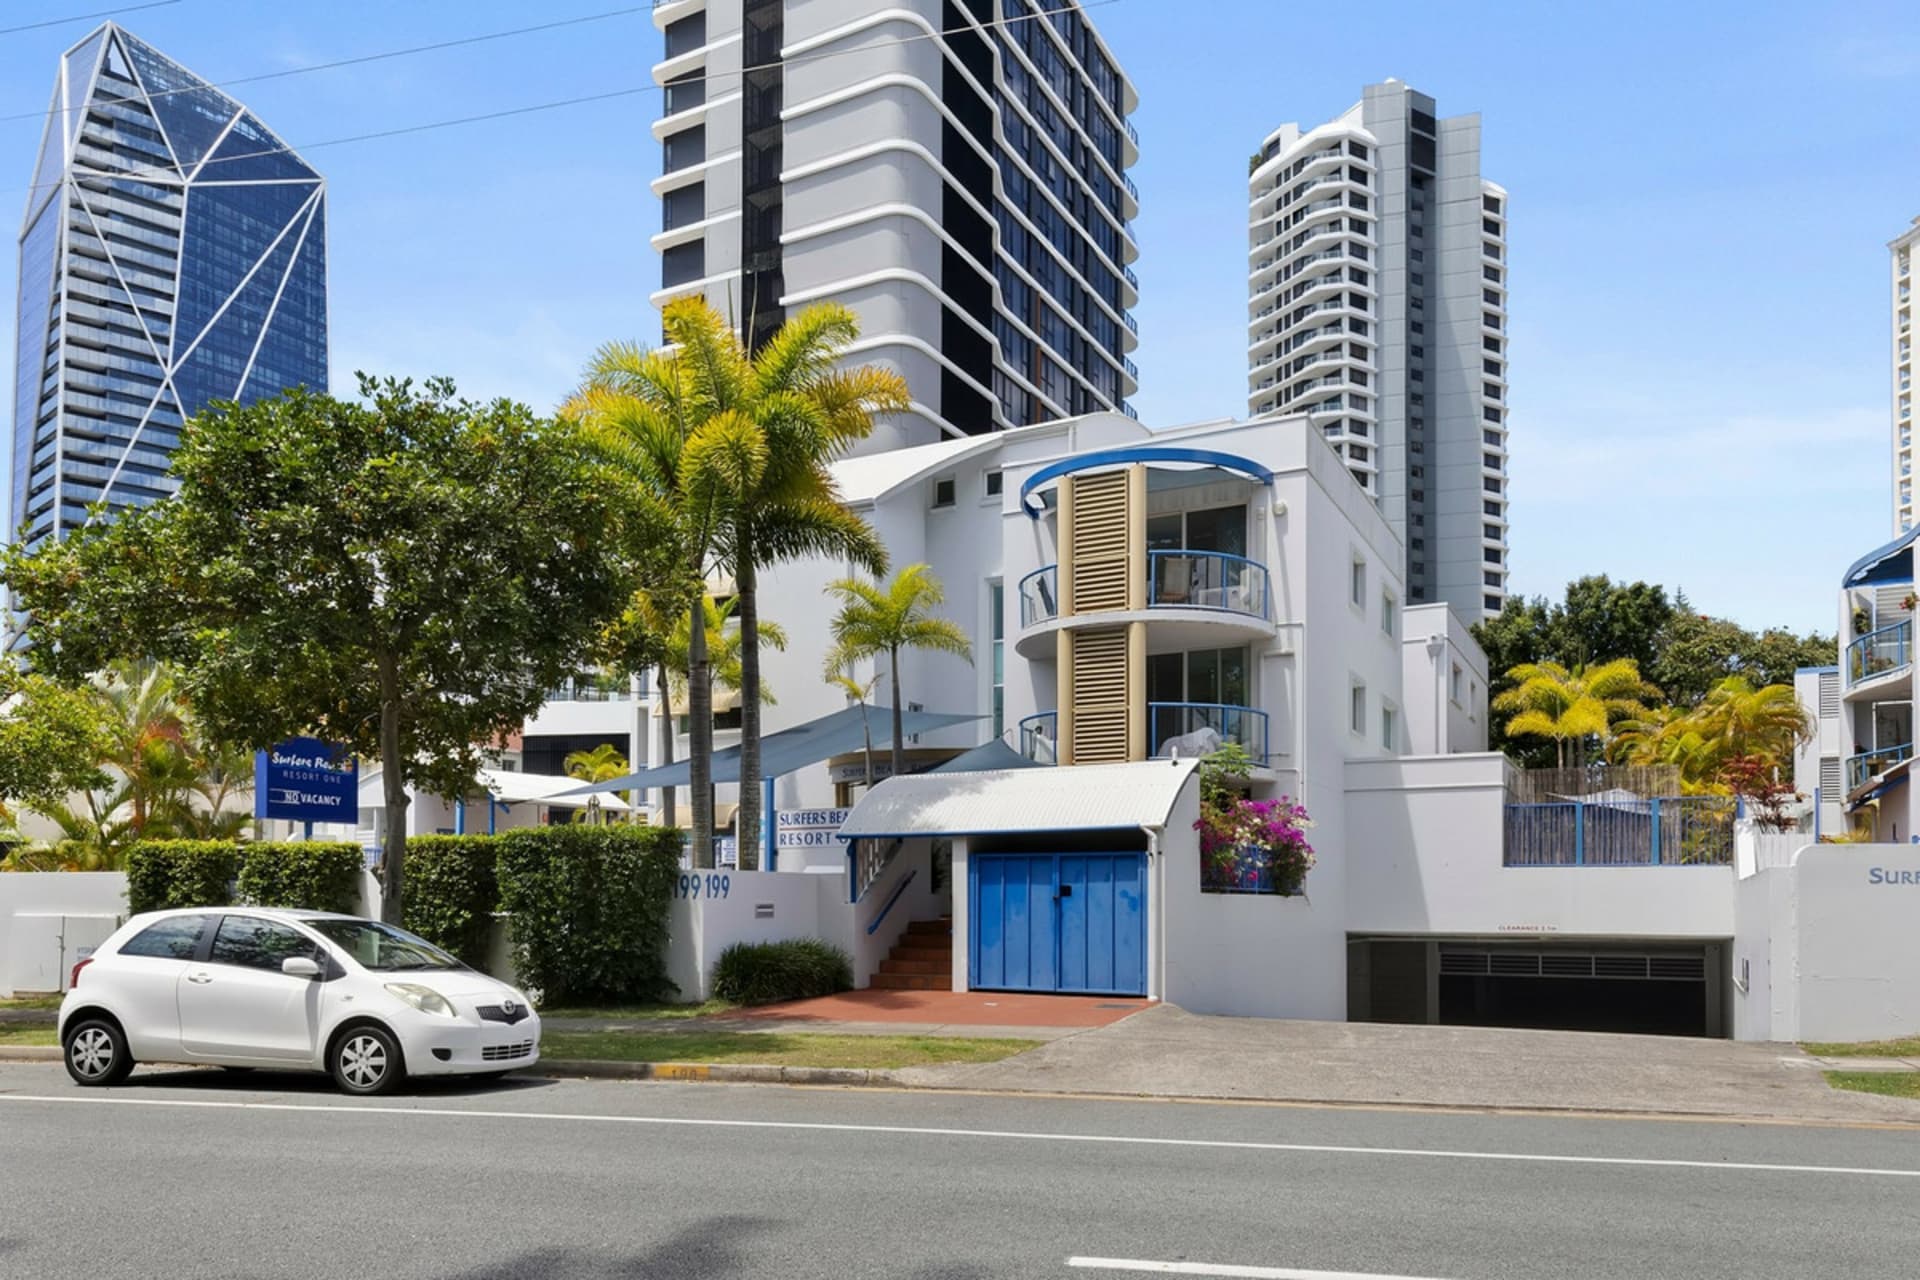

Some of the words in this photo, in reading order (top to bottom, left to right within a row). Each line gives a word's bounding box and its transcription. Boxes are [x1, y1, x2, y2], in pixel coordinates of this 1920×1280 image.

[283, 770, 320, 781] RESORT
[323, 775, 341, 784] ONE
[300, 793, 341, 806] VACANCY
[780, 811, 826, 825] SURFERS
[780, 831, 831, 845] RESORT
[704, 873, 730, 899] 199
